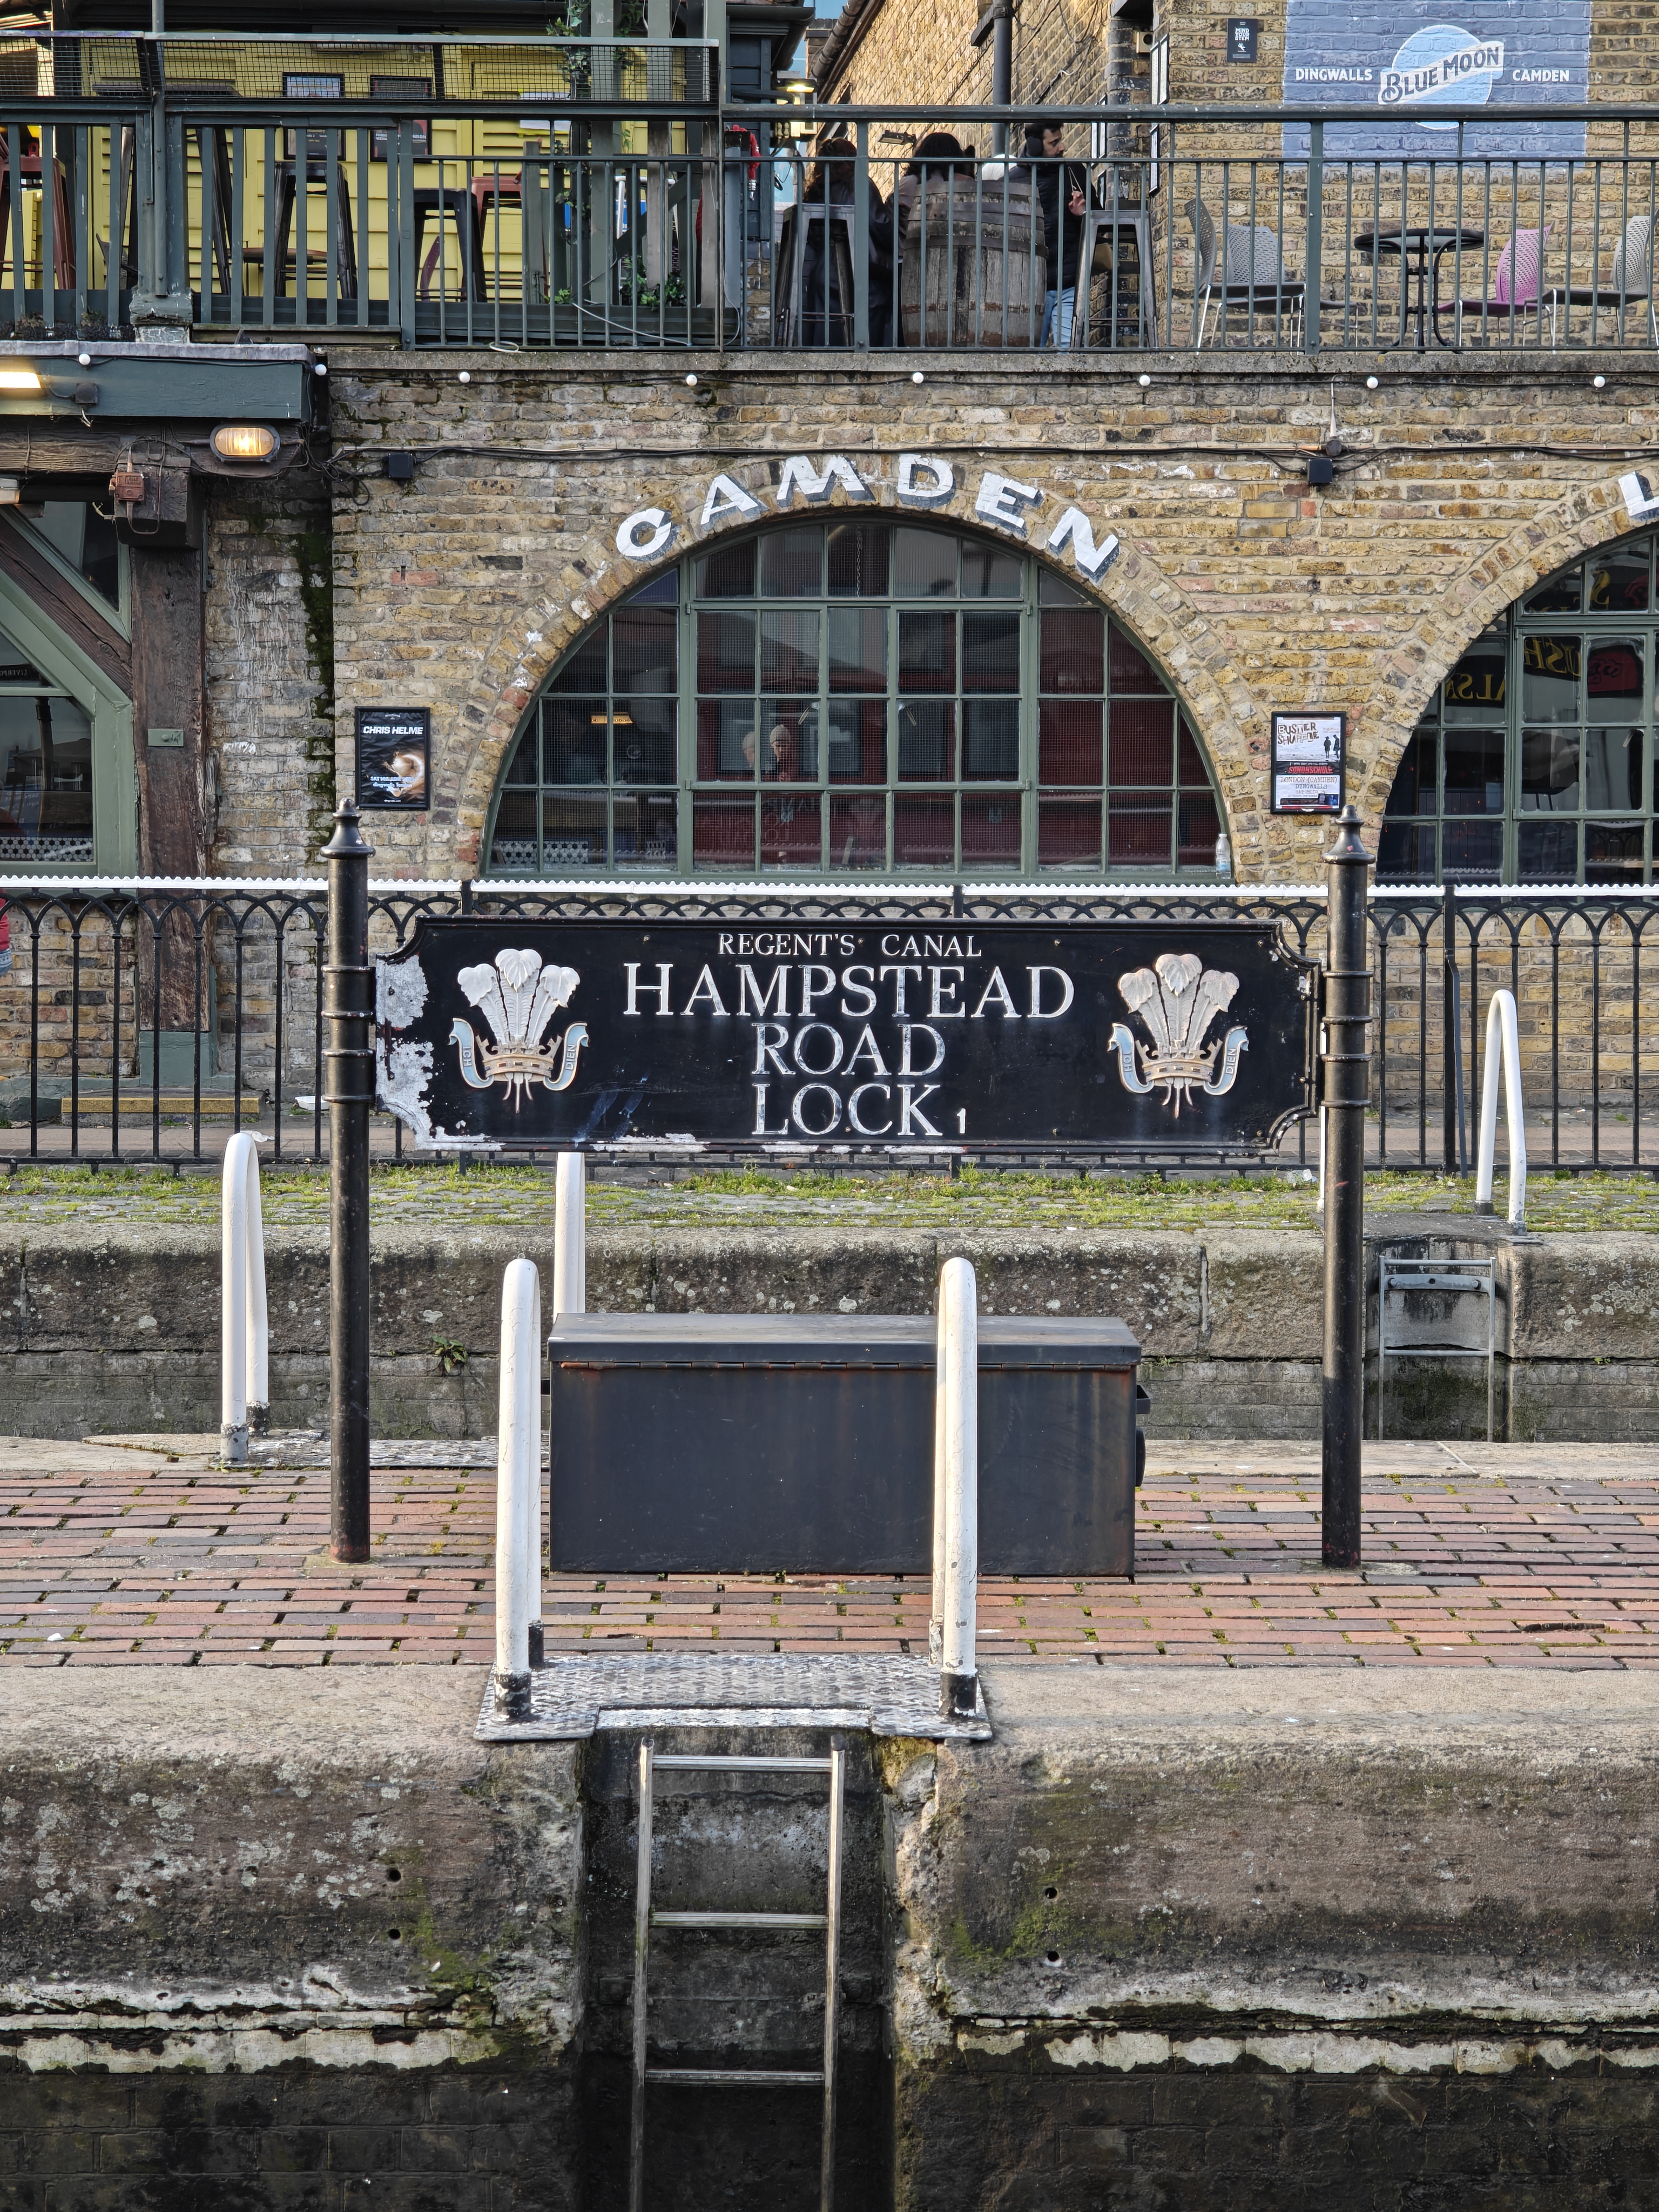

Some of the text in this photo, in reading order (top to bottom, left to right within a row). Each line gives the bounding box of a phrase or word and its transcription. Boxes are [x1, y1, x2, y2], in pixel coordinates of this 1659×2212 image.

[1296, 68, 1373, 82] DINGWALLS
[1380, 46, 1501, 104] BLUE MOON
[1512, 69, 1569, 83] CAMDEN
[616, 453, 1120, 579] CAMDEN
[363, 726, 423, 735] CHRIS HELME
[1278, 722, 1317, 734] BUSTER
[1278, 732, 1319, 745] SHUFFLE
[718, 933, 982, 957] REGENT'S CANAL
[623, 962, 1075, 1020] HAMPSTEAD
[462, 1047, 473, 1067] ICH
[565, 1044, 576, 1071] DIEN
[751, 1022, 946, 1077] ROAD
[1225, 1048, 1236, 1075] DIEN
[751, 1083, 967, 1137] LOCK 1
